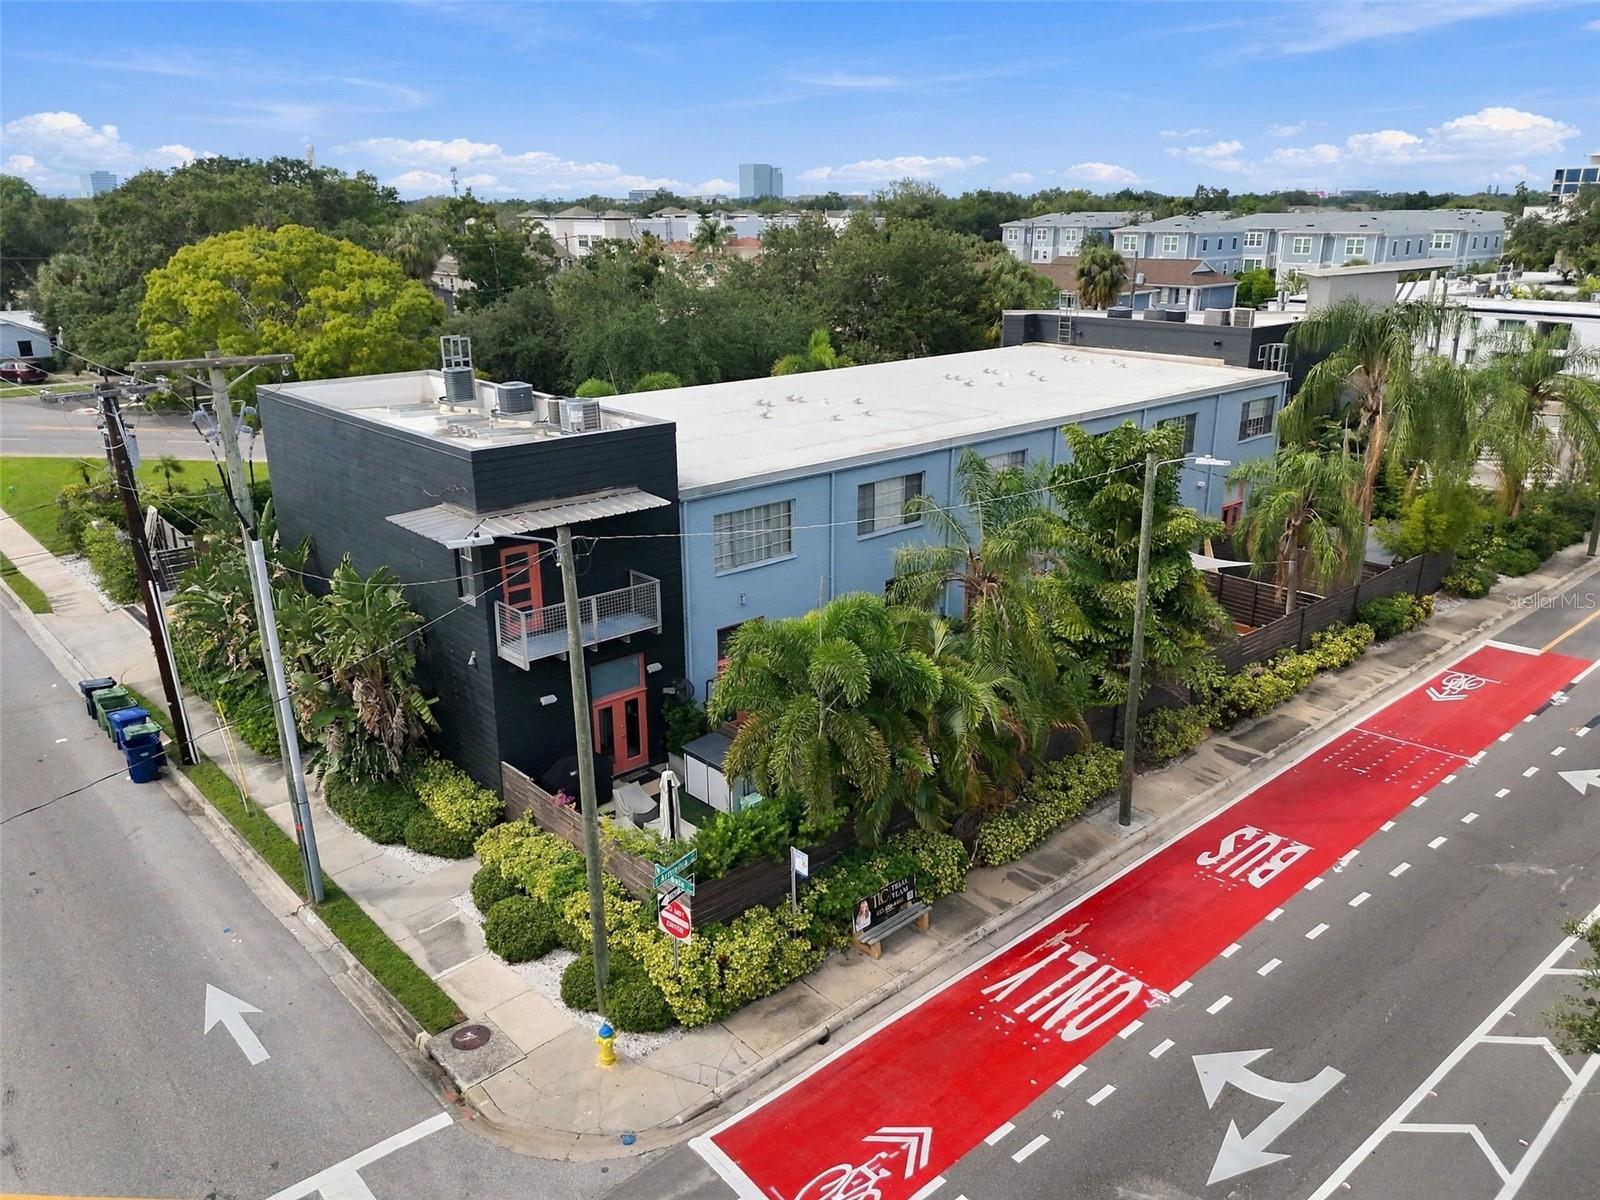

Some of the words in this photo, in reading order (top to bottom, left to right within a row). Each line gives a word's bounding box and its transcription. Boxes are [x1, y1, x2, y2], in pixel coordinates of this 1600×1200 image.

[1196, 824, 1315, 889] BUS
[666, 919, 684, 935] ENTER
[980, 943, 1147, 1042] ONLY
